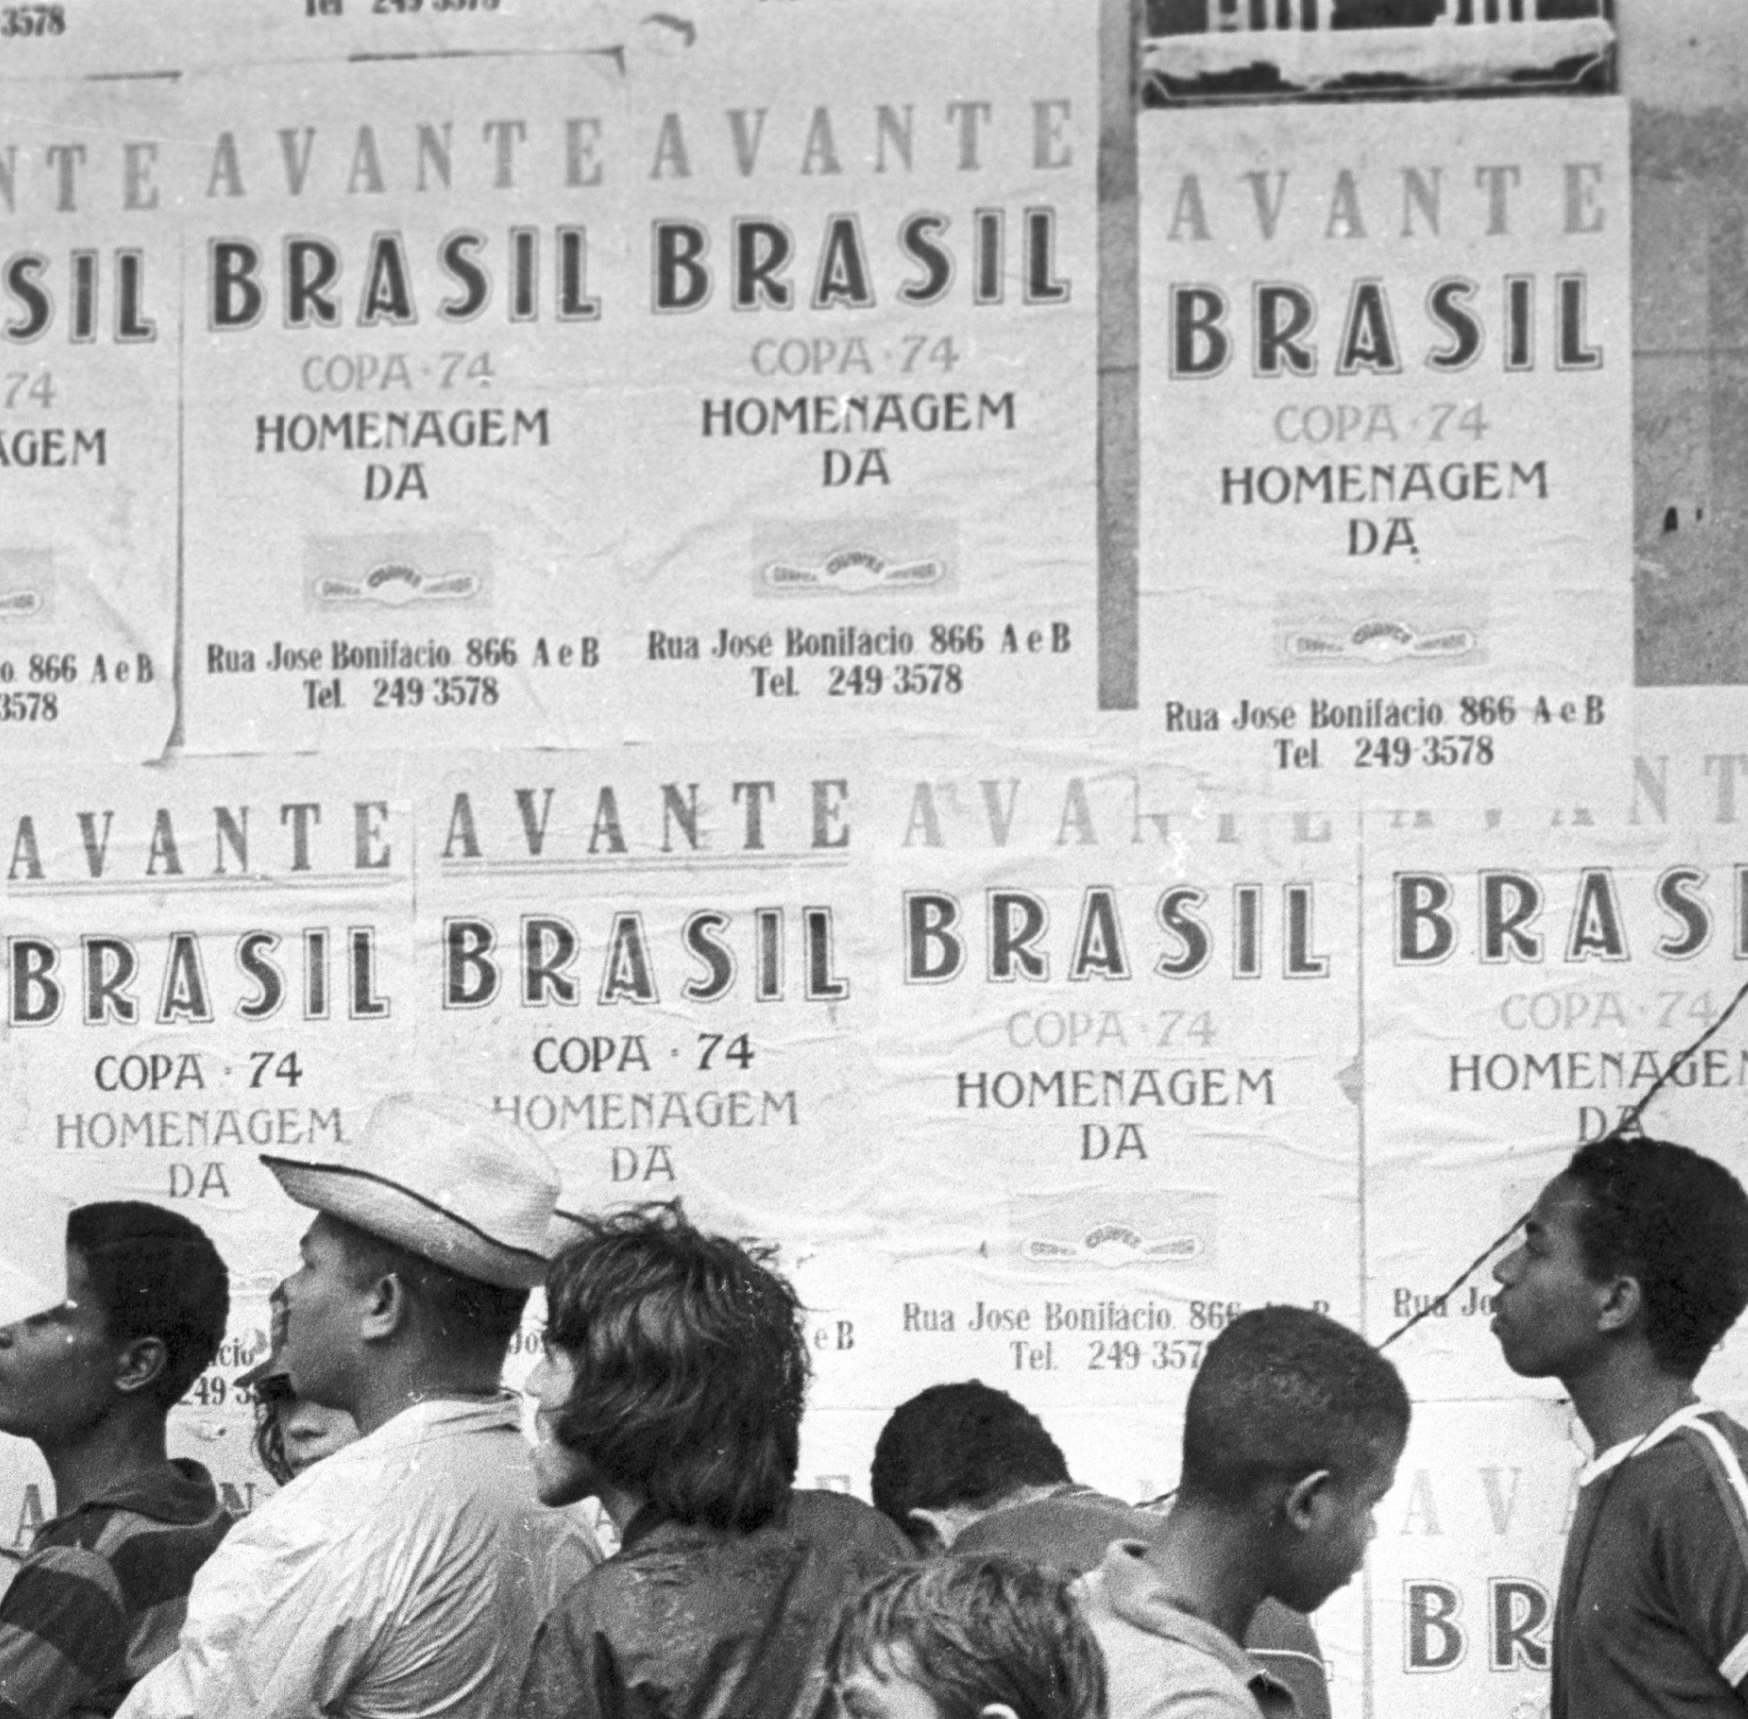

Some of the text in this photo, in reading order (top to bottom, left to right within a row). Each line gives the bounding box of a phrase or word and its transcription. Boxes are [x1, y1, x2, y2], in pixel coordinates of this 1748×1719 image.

[203, 116, 606, 200] AVANTE
[648, 98, 1075, 181] AVANTE
[1166, 162, 1608, 244] AVANTE
[206, 224, 601, 332] BRASIL
[650, 205, 1071, 314] BRASIL
[1168, 269, 1604, 380] BRASIL
[255, 407, 550, 453] HOMENAGEM
[701, 391, 1015, 438] HOMENAGEM
[364, 461, 428, 502] DA
[822, 447, 891, 487] DA
[1221, 460, 1549, 505] HOMENAGEM
[1347, 516, 1419, 556] DA
[647, 630, 700, 661] Rua
[929, 624, 985, 654] 866
[1051, 621, 1071, 653] B
[1165, 701, 1220, 732] Rua
[1459, 696, 1517, 725] 866
[1585, 694, 1605, 725] B
[6, 799, 392, 882] AVANTE
[442, 779, 851, 858] AVANTE
[902, 879, 1330, 985] BRASIL
[439, 904, 850, 1011] BRASIL
[94, 1053, 205, 1092] COPA
[532, 1035, 651, 1075] COPA
[955, 1068, 1275, 1109] HOMENAGEM
[55, 1107, 349, 1150] HOMENAGEM
[1080, 1122, 1148, 1161] DA
[164, 1161, 231, 1200] DA
[610, 1144, 677, 1183] DA
